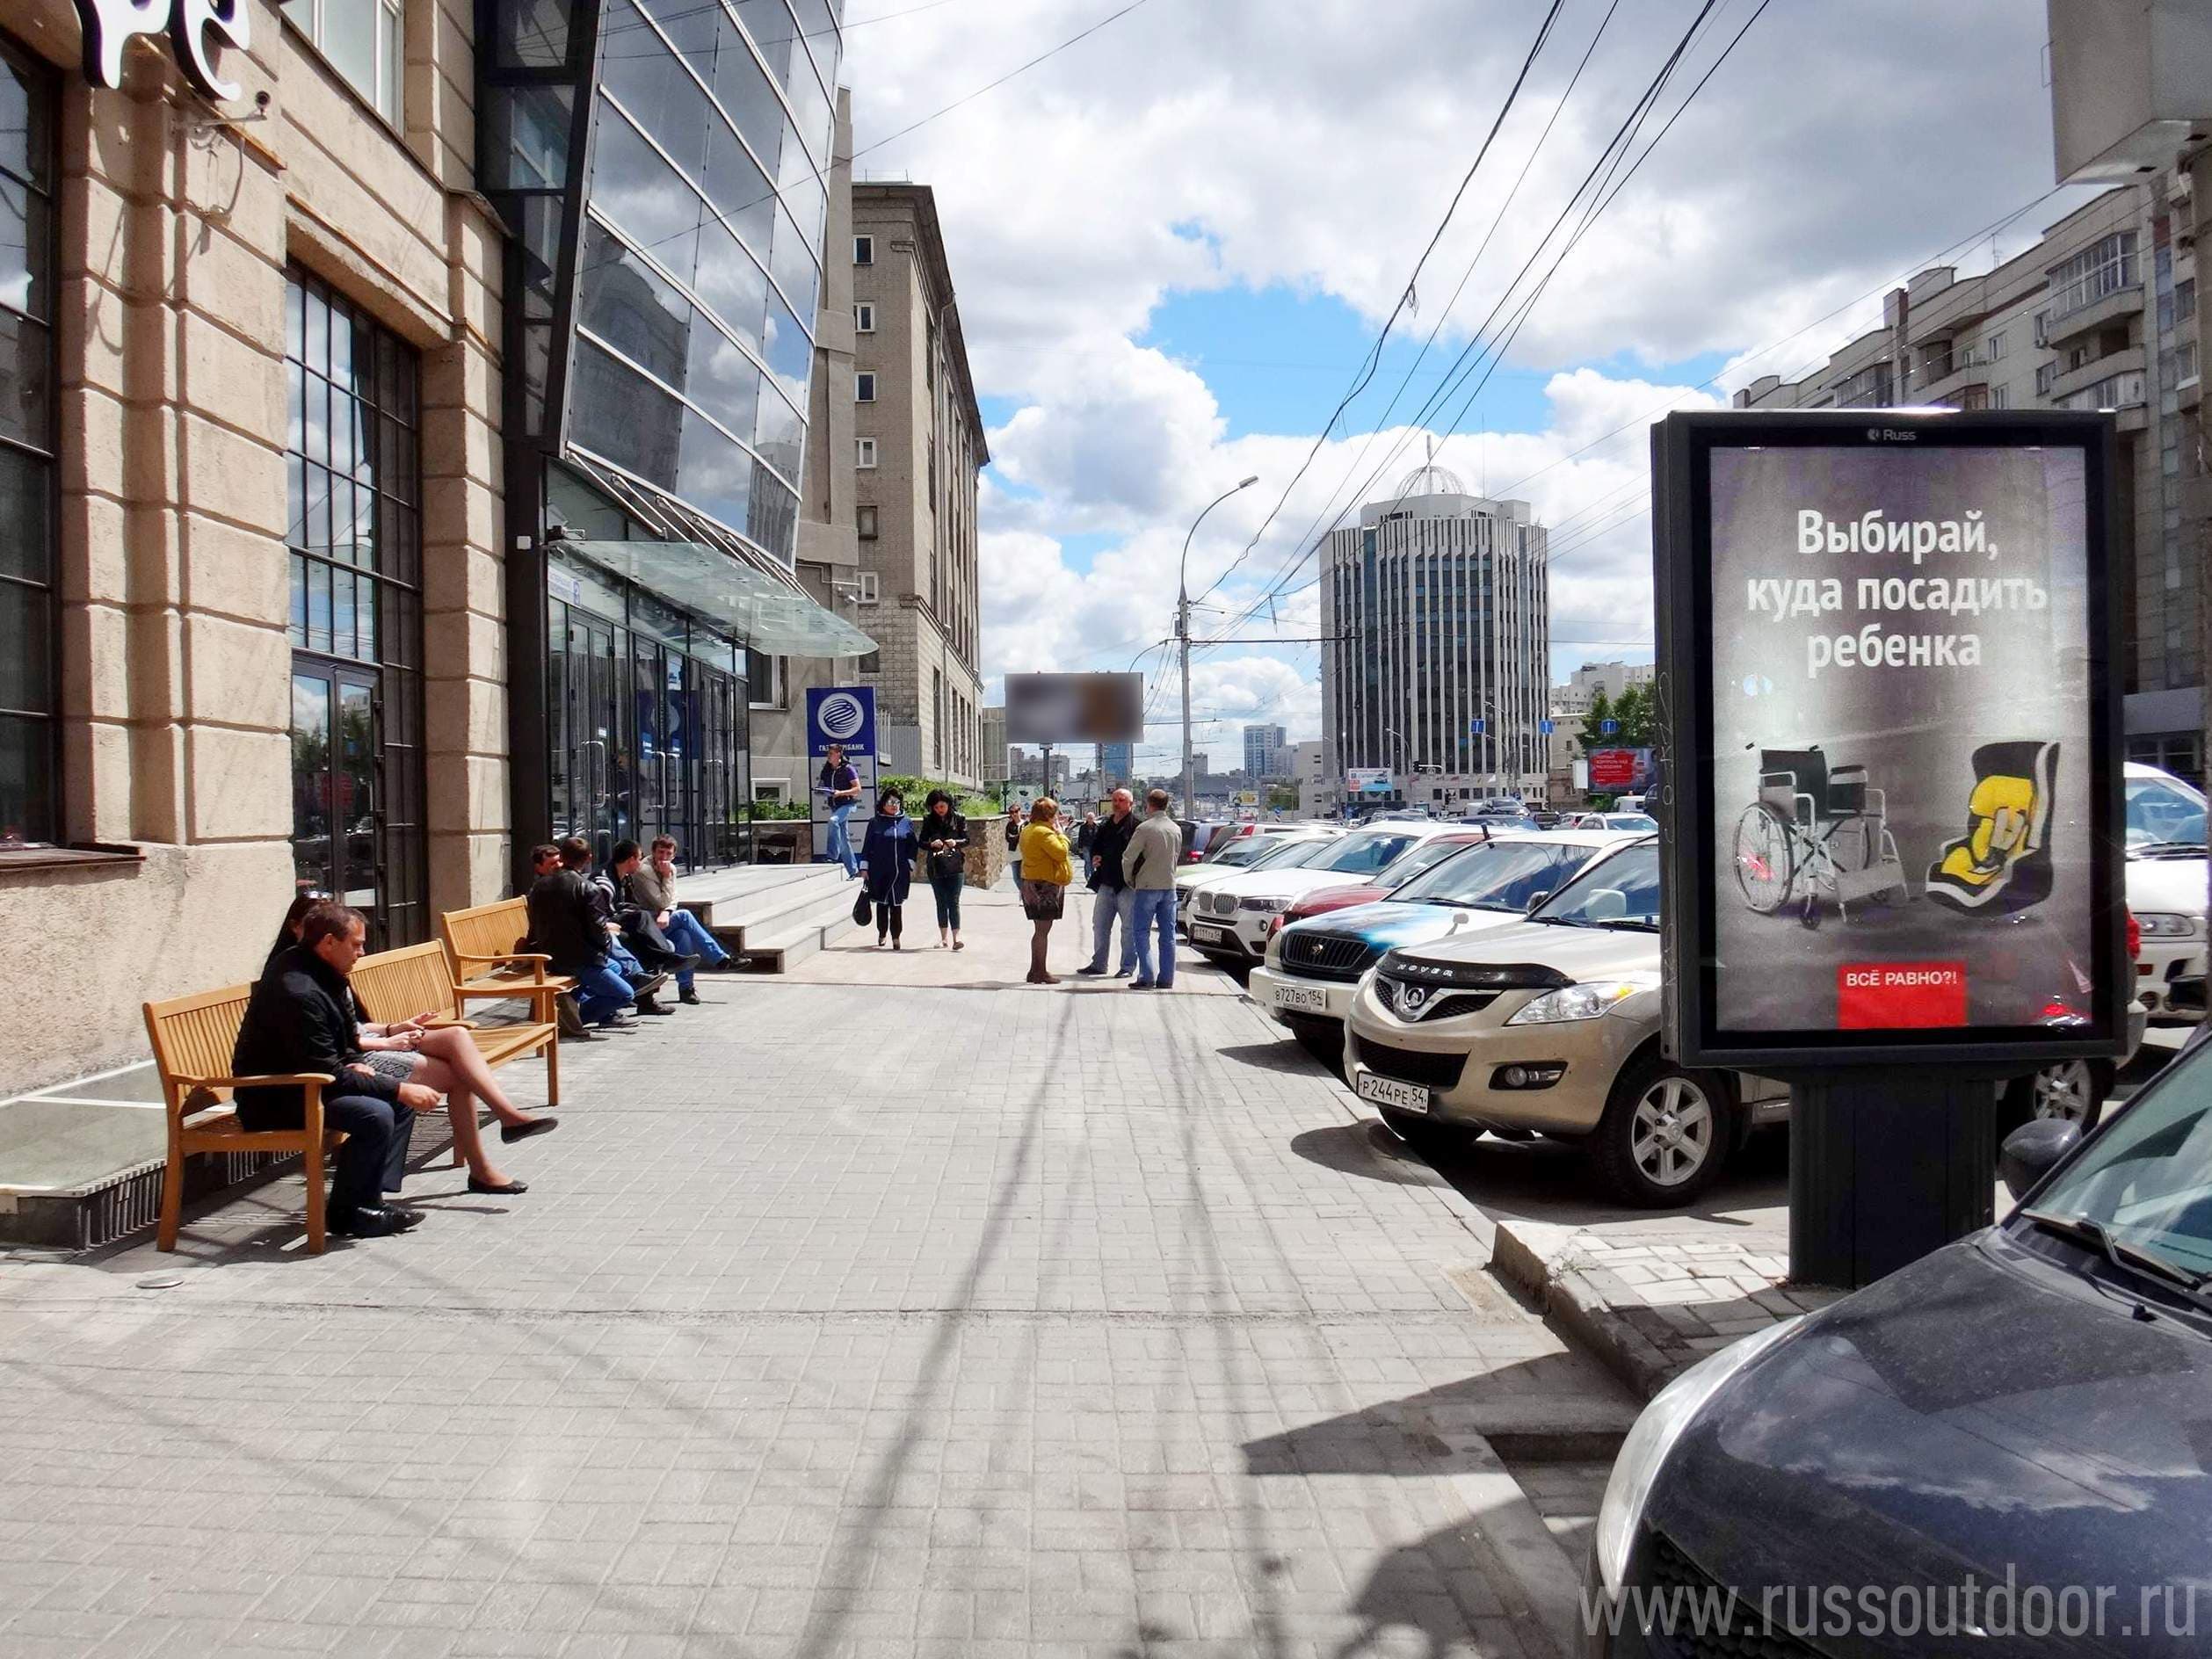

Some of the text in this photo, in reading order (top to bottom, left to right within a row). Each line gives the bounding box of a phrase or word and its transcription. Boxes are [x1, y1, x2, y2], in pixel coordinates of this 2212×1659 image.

[1882, 428, 1917, 441] Russ
[1797, 509, 1998, 565] Выбирай,
[1746, 576, 2049, 623] куда посадить
[1807, 622, 1982, 679] ребенка
[1396, 963, 1454, 977] HOVER
[1846, 969, 1958, 987] ВСЁ РАВНО?!
[1411, 1087, 1424, 1105] 54
